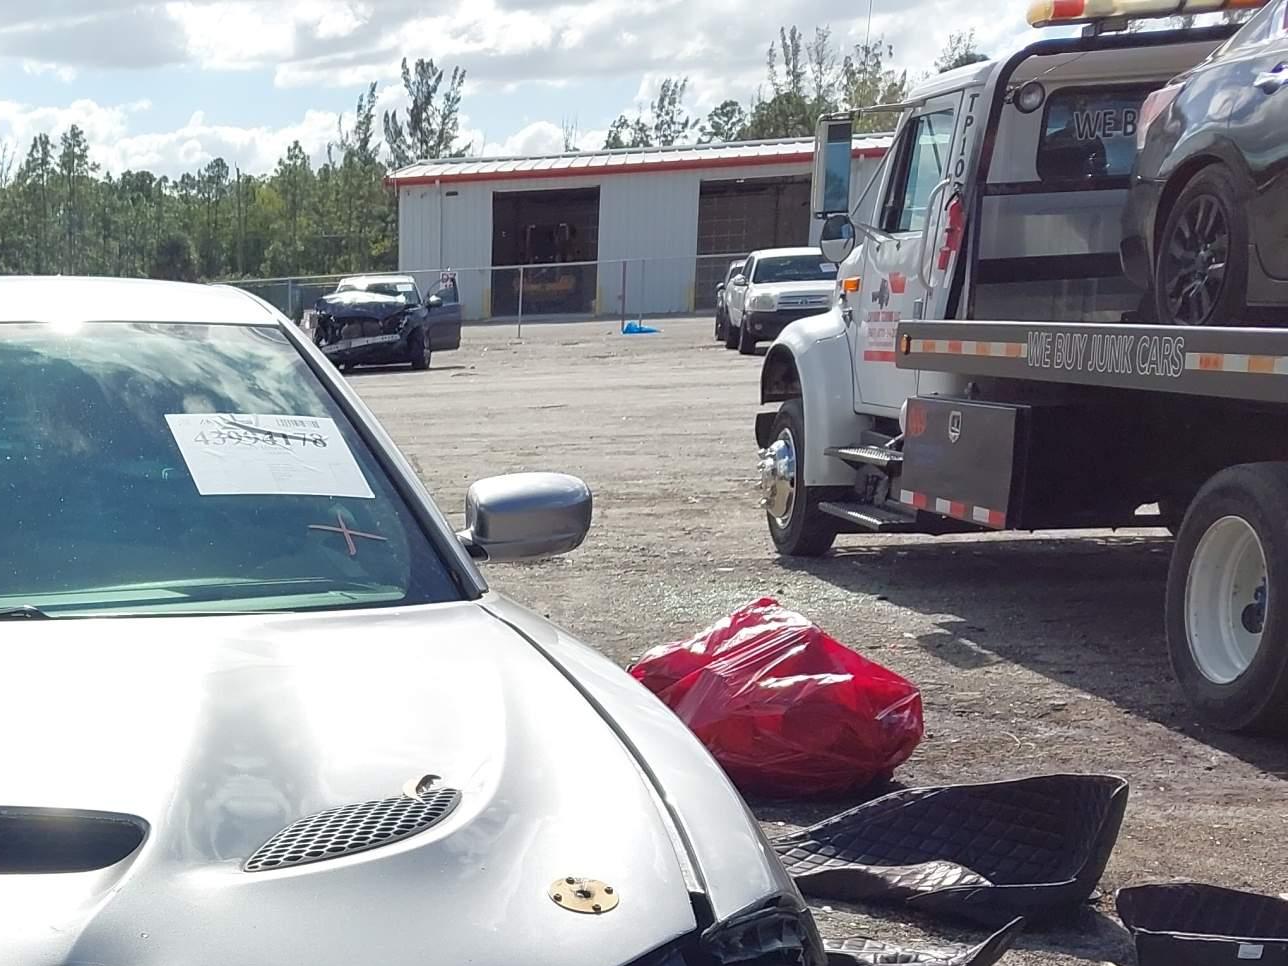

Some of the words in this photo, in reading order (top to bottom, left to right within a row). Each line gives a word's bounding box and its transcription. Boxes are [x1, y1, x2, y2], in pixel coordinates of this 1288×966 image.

[1073, 108, 1116, 141] WE
[1027, 331, 1052, 368] WE
[1054, 332, 1088, 371] BUY
[1087, 334, 1134, 374] JUNK
[1136, 335, 1185, 378] CARS
